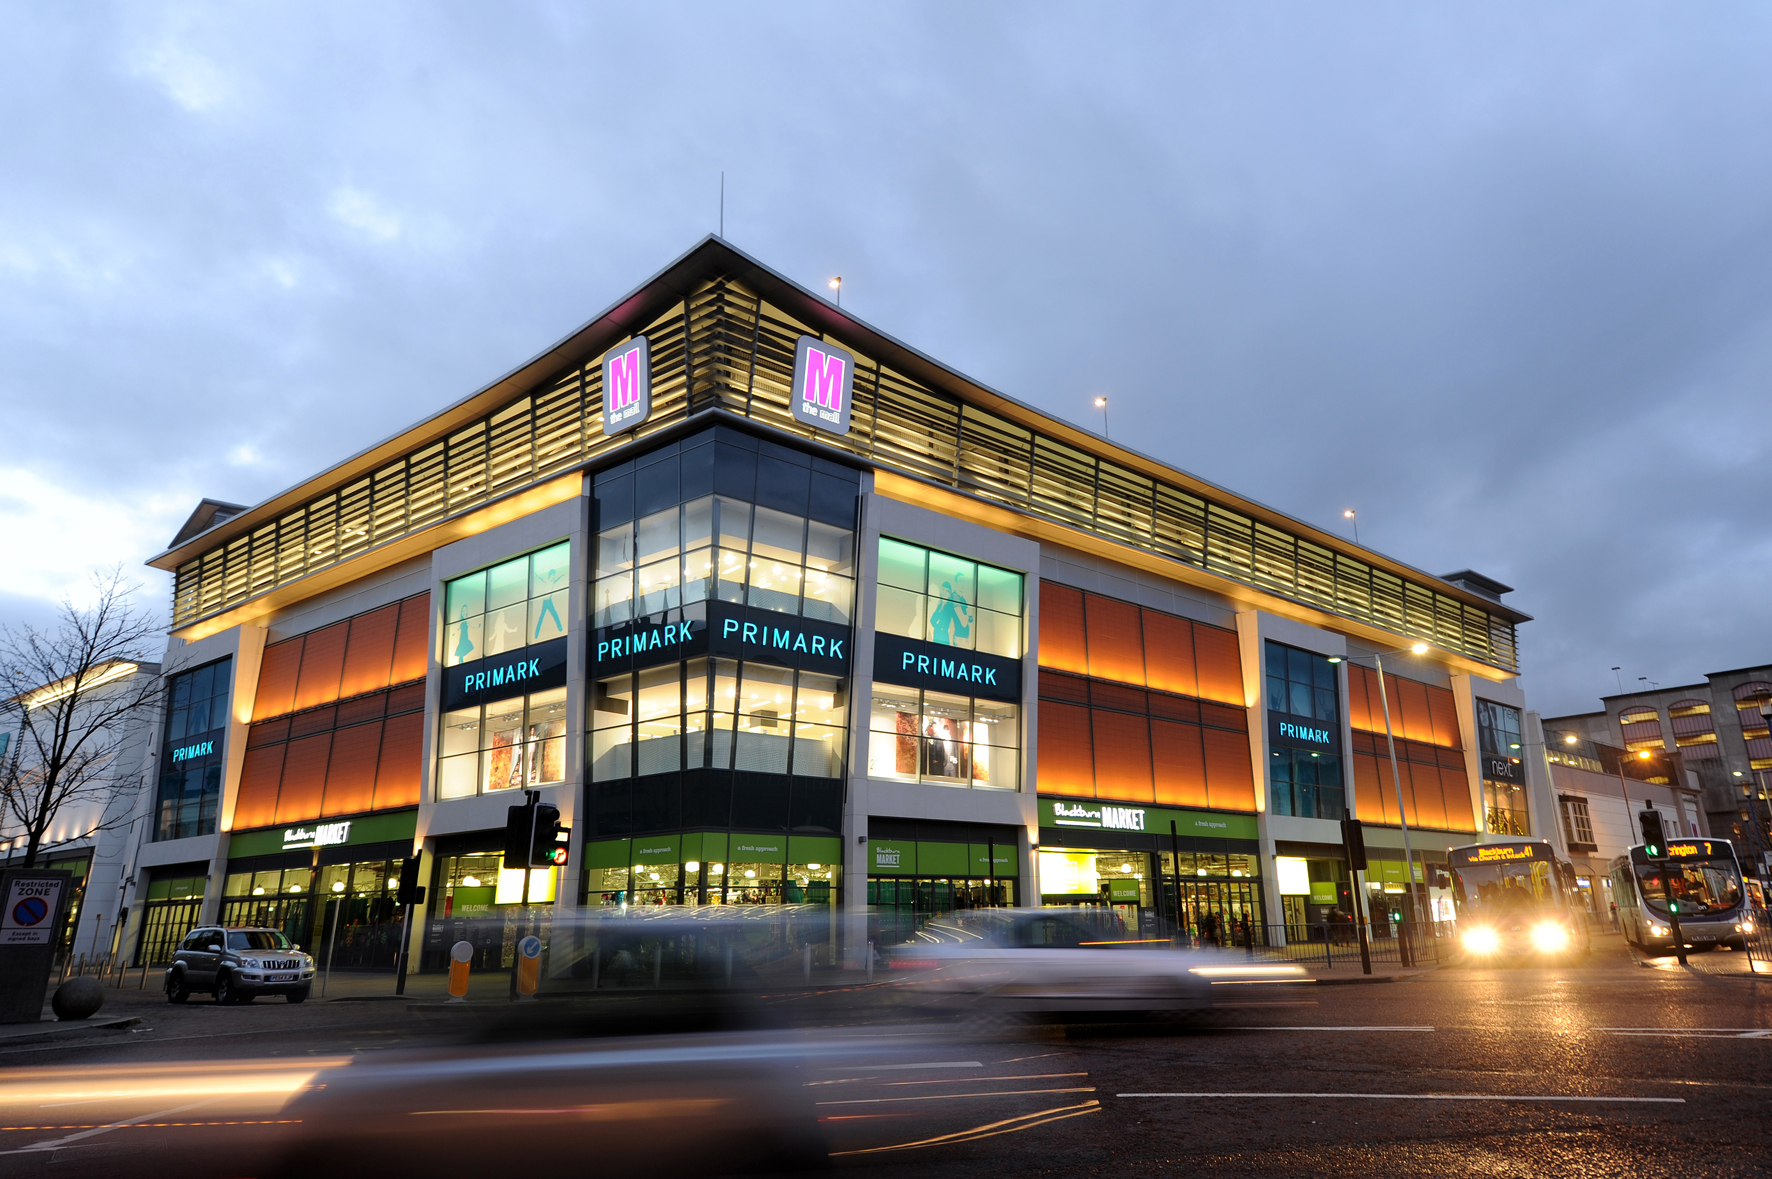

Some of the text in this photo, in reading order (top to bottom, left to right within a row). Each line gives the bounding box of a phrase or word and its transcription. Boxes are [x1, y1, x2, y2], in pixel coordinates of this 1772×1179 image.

[609, 347, 640, 413] M
[803, 346, 846, 412] M
[610, 402, 641, 425] the mall
[802, 402, 841, 424] the mall
[598, 621, 693, 661] PRIMARK
[722, 618, 844, 660] PRIMARK
[465, 658, 540, 693] PRIMARK
[902, 651, 997, 686] PRIMARK
[1280, 721, 1330, 744] PRIMARK
[172, 740, 214, 763] PRIMARK
[1491, 760, 1514, 777] next
[1053, 802, 1145, 831] Blackburn MARKET
[314, 821, 352, 846] MARKET
[876, 854, 900, 864] MARKET
[1478, 847, 1514, 856] Blackburn
[1478, 854, 1501, 862] Church
[1523, 845, 1534, 857] 41
[1704, 842, 1711, 855] 7
[14, 880, 60, 888] Restricted
[17, 887, 51, 896] ZONE
[1112, 889, 1137, 897] WELCOME
[461, 904, 489, 912] WELCOME
